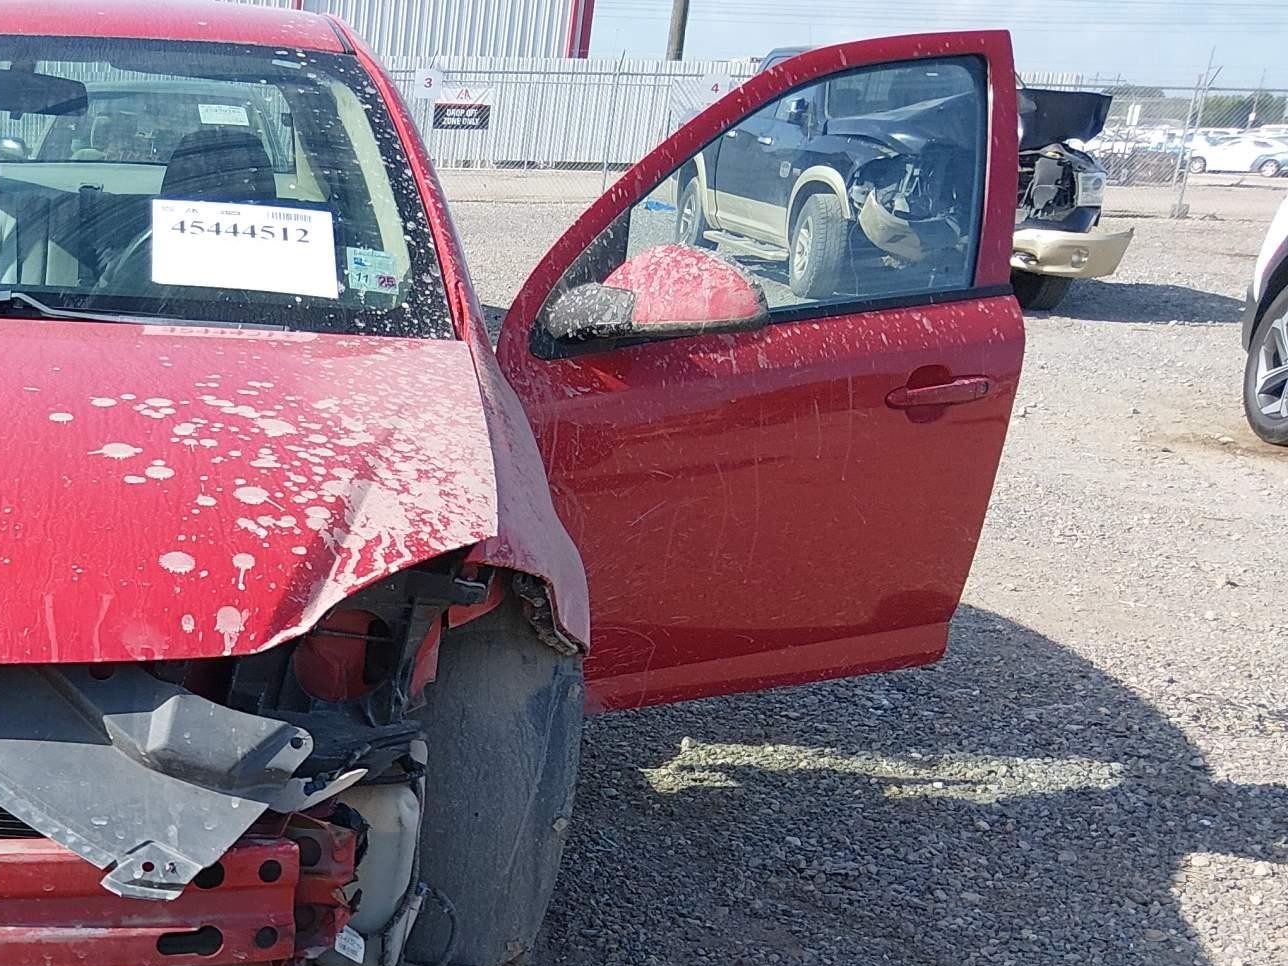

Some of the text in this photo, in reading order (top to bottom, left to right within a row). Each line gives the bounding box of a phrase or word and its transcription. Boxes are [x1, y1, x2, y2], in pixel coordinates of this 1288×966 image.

[424, 78, 433, 88] 3
[711, 83, 719, 93] 4
[446, 109, 464, 117] DROP
[442, 117, 480, 126] ZONE ONLY
[171, 220, 311, 243] 45444512
[355, 272, 395, 289] 11 25
